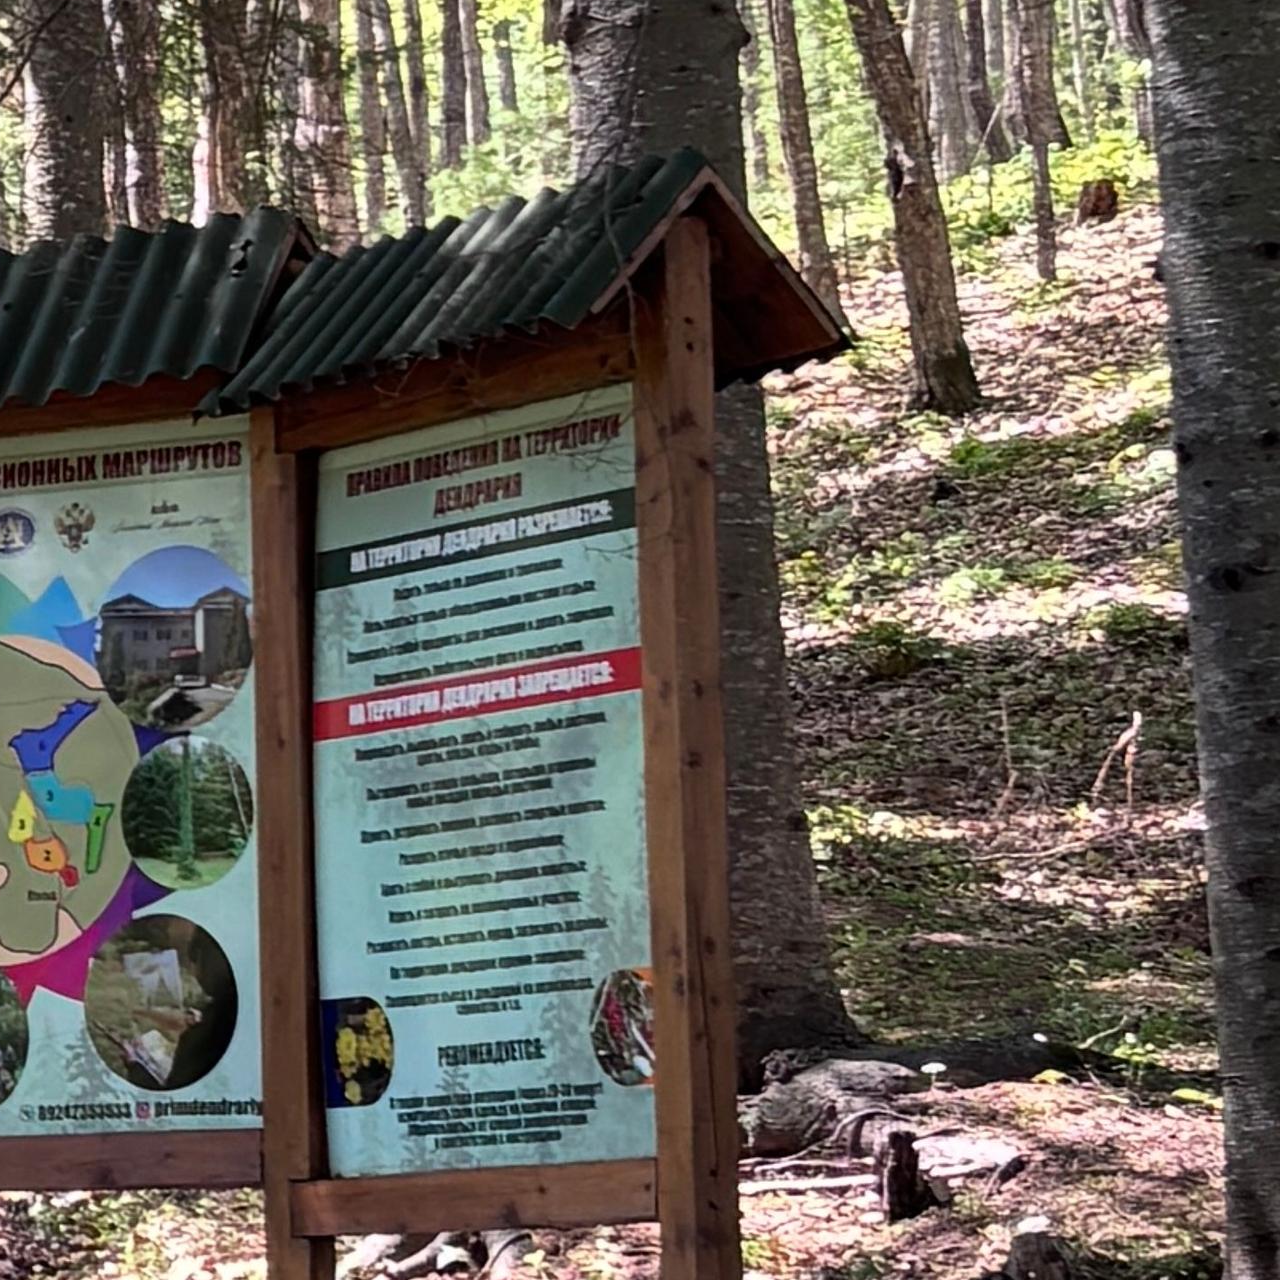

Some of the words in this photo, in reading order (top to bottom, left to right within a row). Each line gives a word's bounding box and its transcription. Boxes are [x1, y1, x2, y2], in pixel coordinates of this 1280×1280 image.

[102, 440, 243, 479] МАРШРУТОВ
[346, 460, 411, 497] ПРАВИЛА
[414, 440, 498, 483] ПОВЕДЕНИЯ
[501, 434, 522, 462] НА
[433, 472, 522, 518] ДЕНДРАРИЯ
